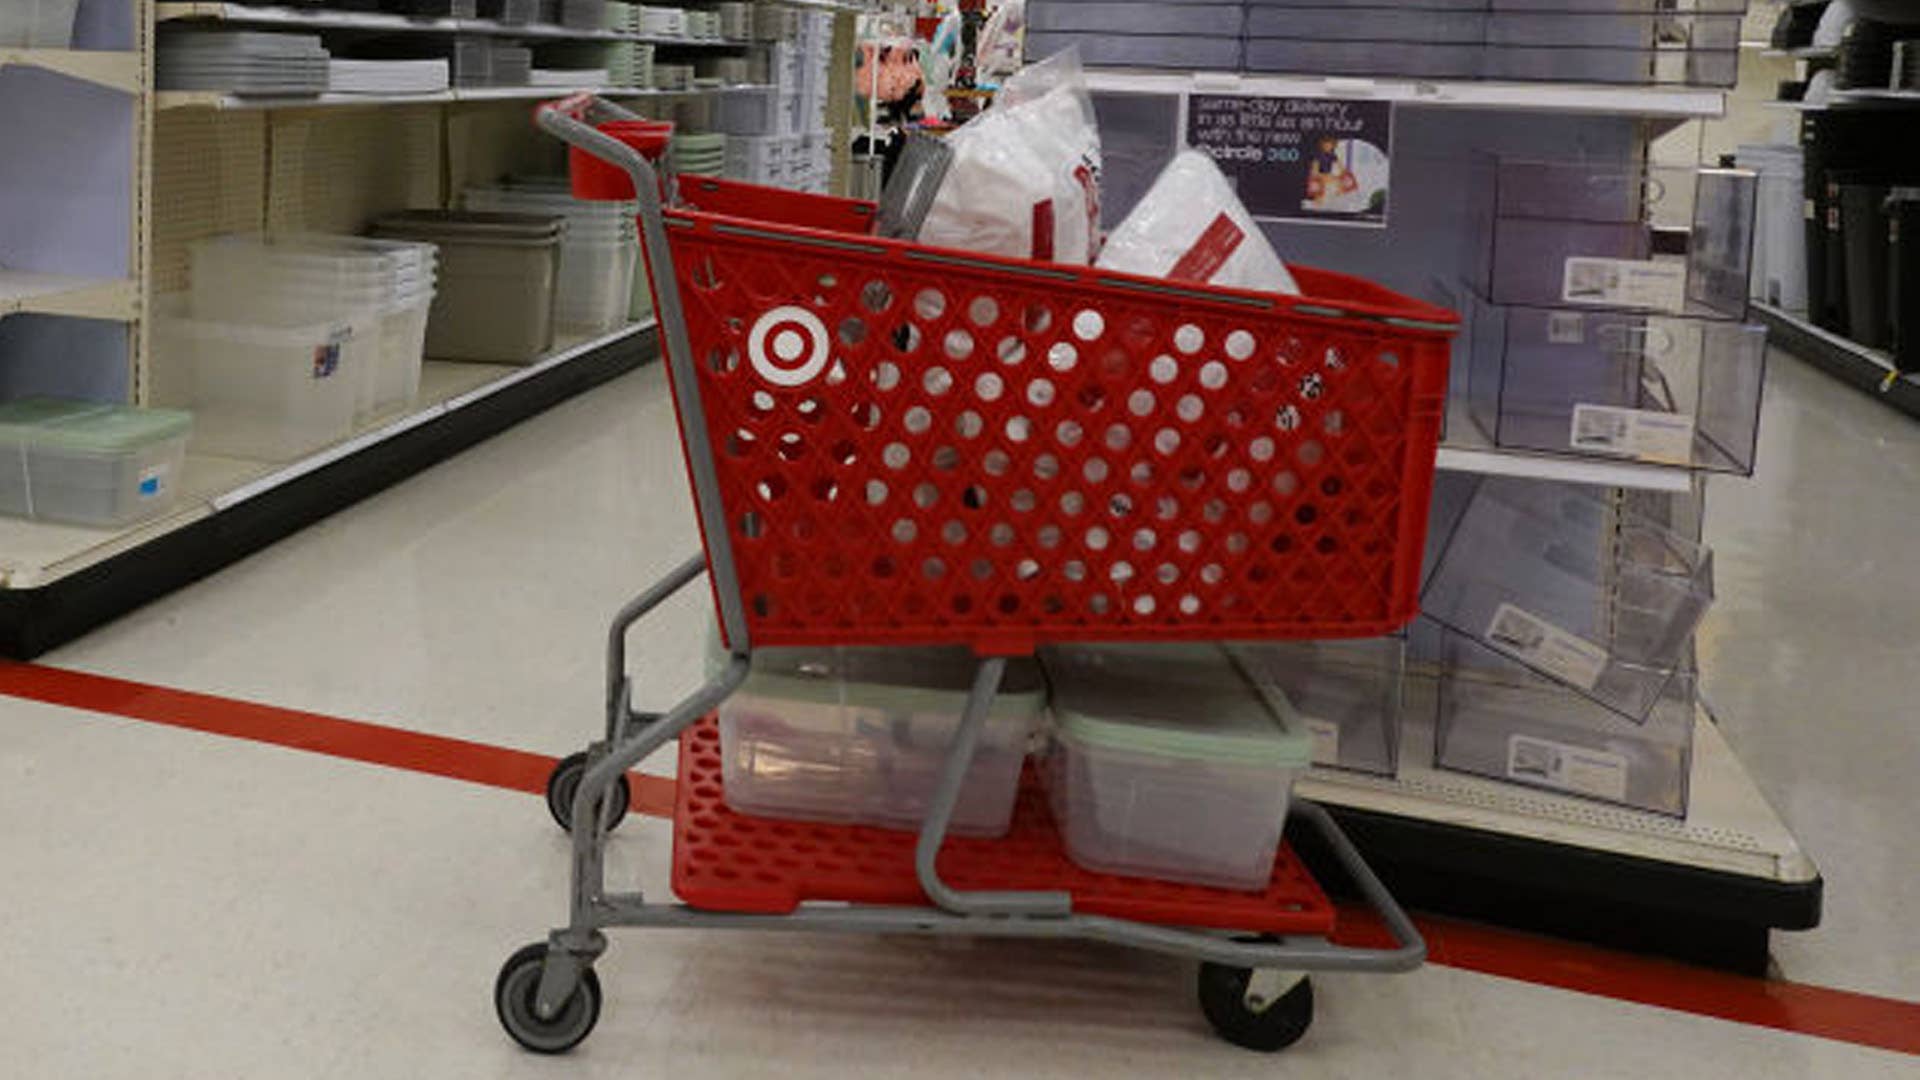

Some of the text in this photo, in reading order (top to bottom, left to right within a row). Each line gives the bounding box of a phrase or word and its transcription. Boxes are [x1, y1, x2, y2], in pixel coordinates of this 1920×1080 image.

[1199, 98, 1350, 118] Same-day delivery
[1197, 113, 1213, 126] in
[1324, 116, 1364, 131] hour
[1197, 129, 1301, 145] with the new
[1266, 148, 1300, 162] 360
